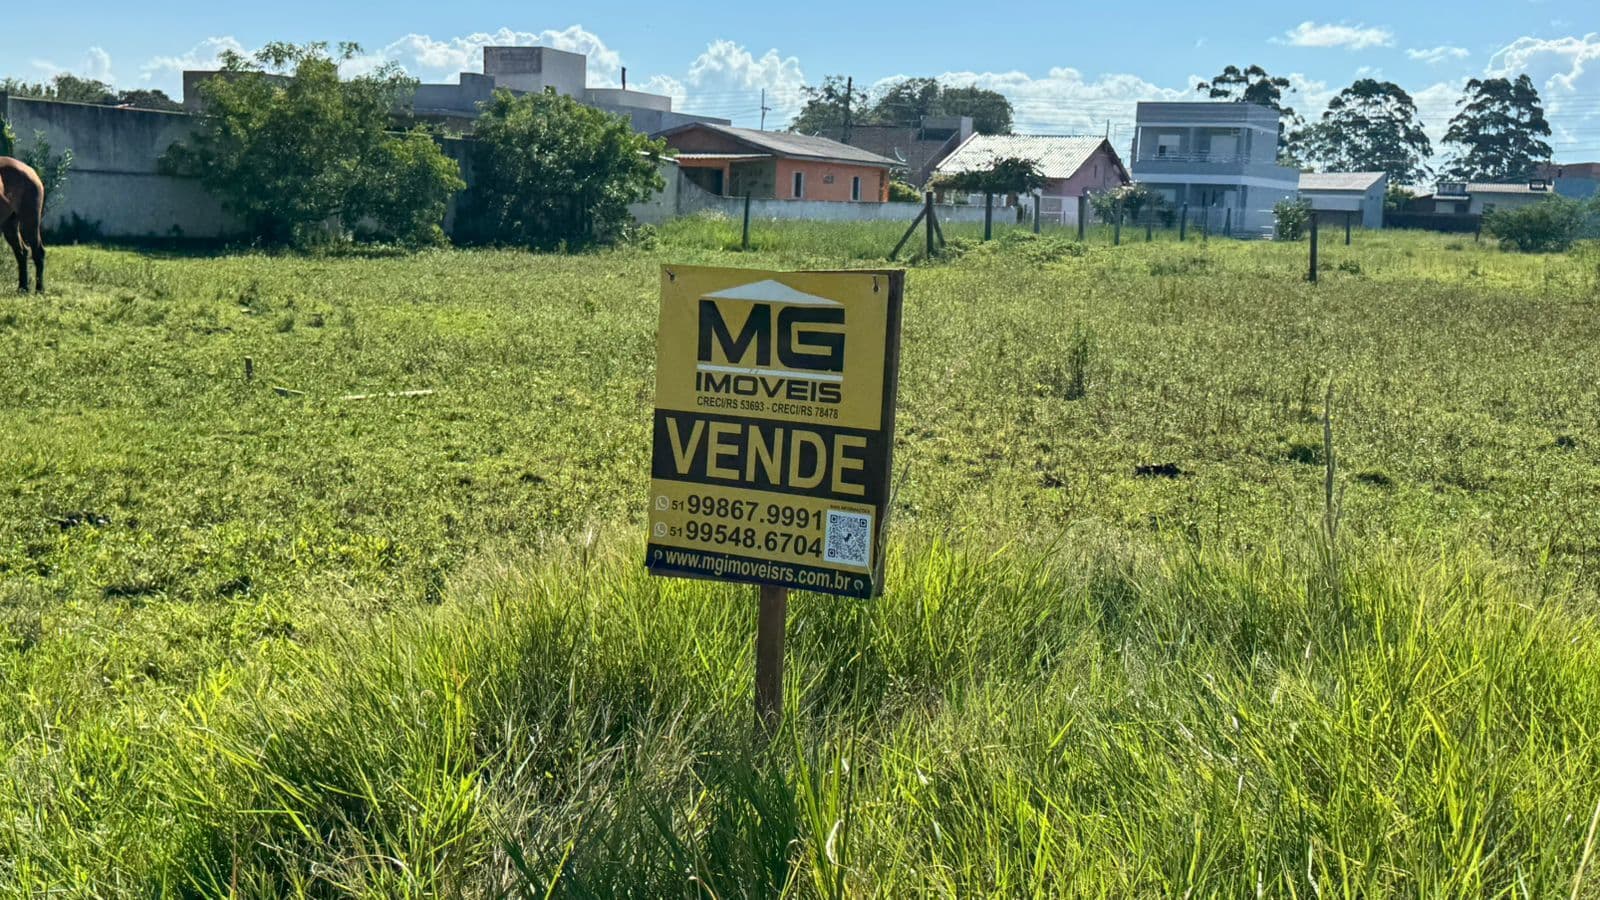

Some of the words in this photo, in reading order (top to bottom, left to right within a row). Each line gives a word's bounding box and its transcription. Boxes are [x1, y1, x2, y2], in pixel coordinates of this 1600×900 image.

[698, 299, 845, 373] MG
[697, 396, 738, 409] CRECI/RS
[740, 400, 764, 412] 53693
[772, 403, 812, 417] CRECI/RS
[815, 406, 839, 420] 78478
[666, 417, 867, 496] VENDE
[672, 500, 684, 511] 51
[688, 494, 822, 531] 99867.9991
[670, 526, 682, 537] 51
[686, 520, 822, 558] 99548.6704
[665, 551, 851, 590] www.mgimoveisrs.com.br
